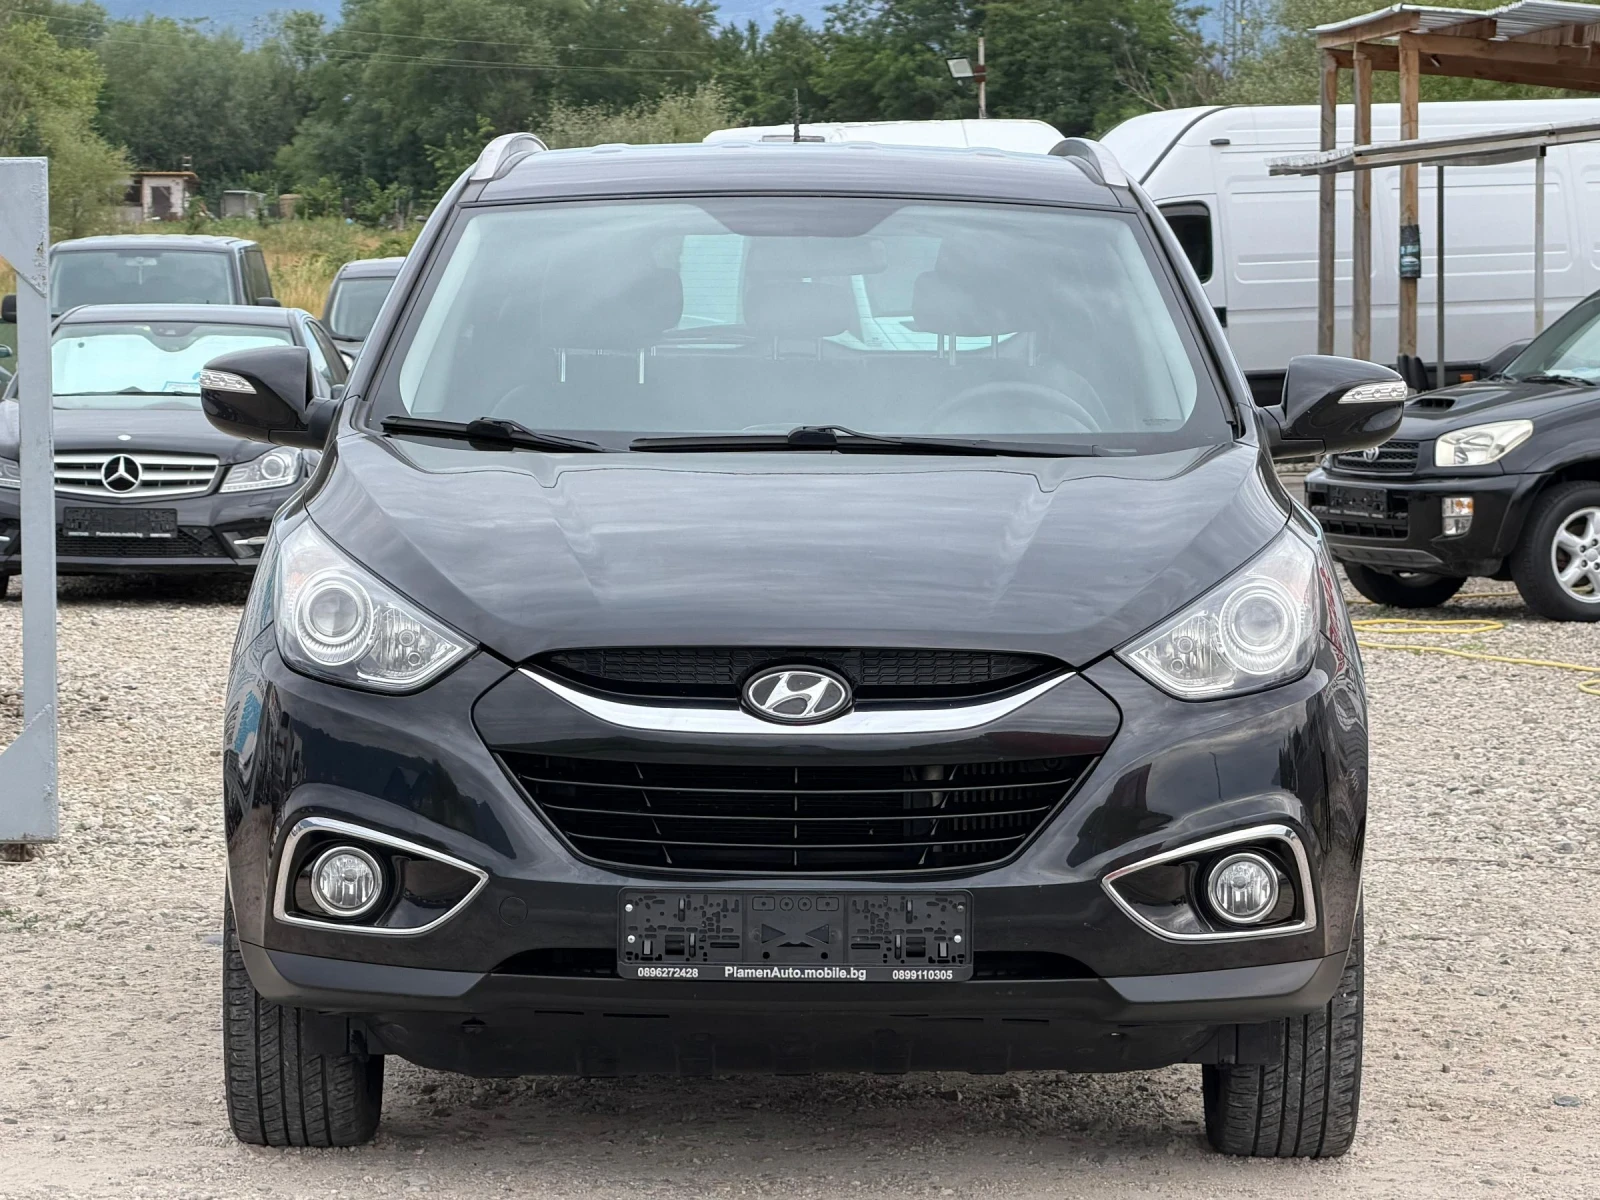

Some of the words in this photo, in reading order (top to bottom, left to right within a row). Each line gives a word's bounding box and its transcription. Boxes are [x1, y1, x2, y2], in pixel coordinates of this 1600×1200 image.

[637, 967, 699, 978] 0896272428
[724, 966, 867, 981] PlamenAuto.mobile.bg
[892, 969, 953, 980] 0899110305
